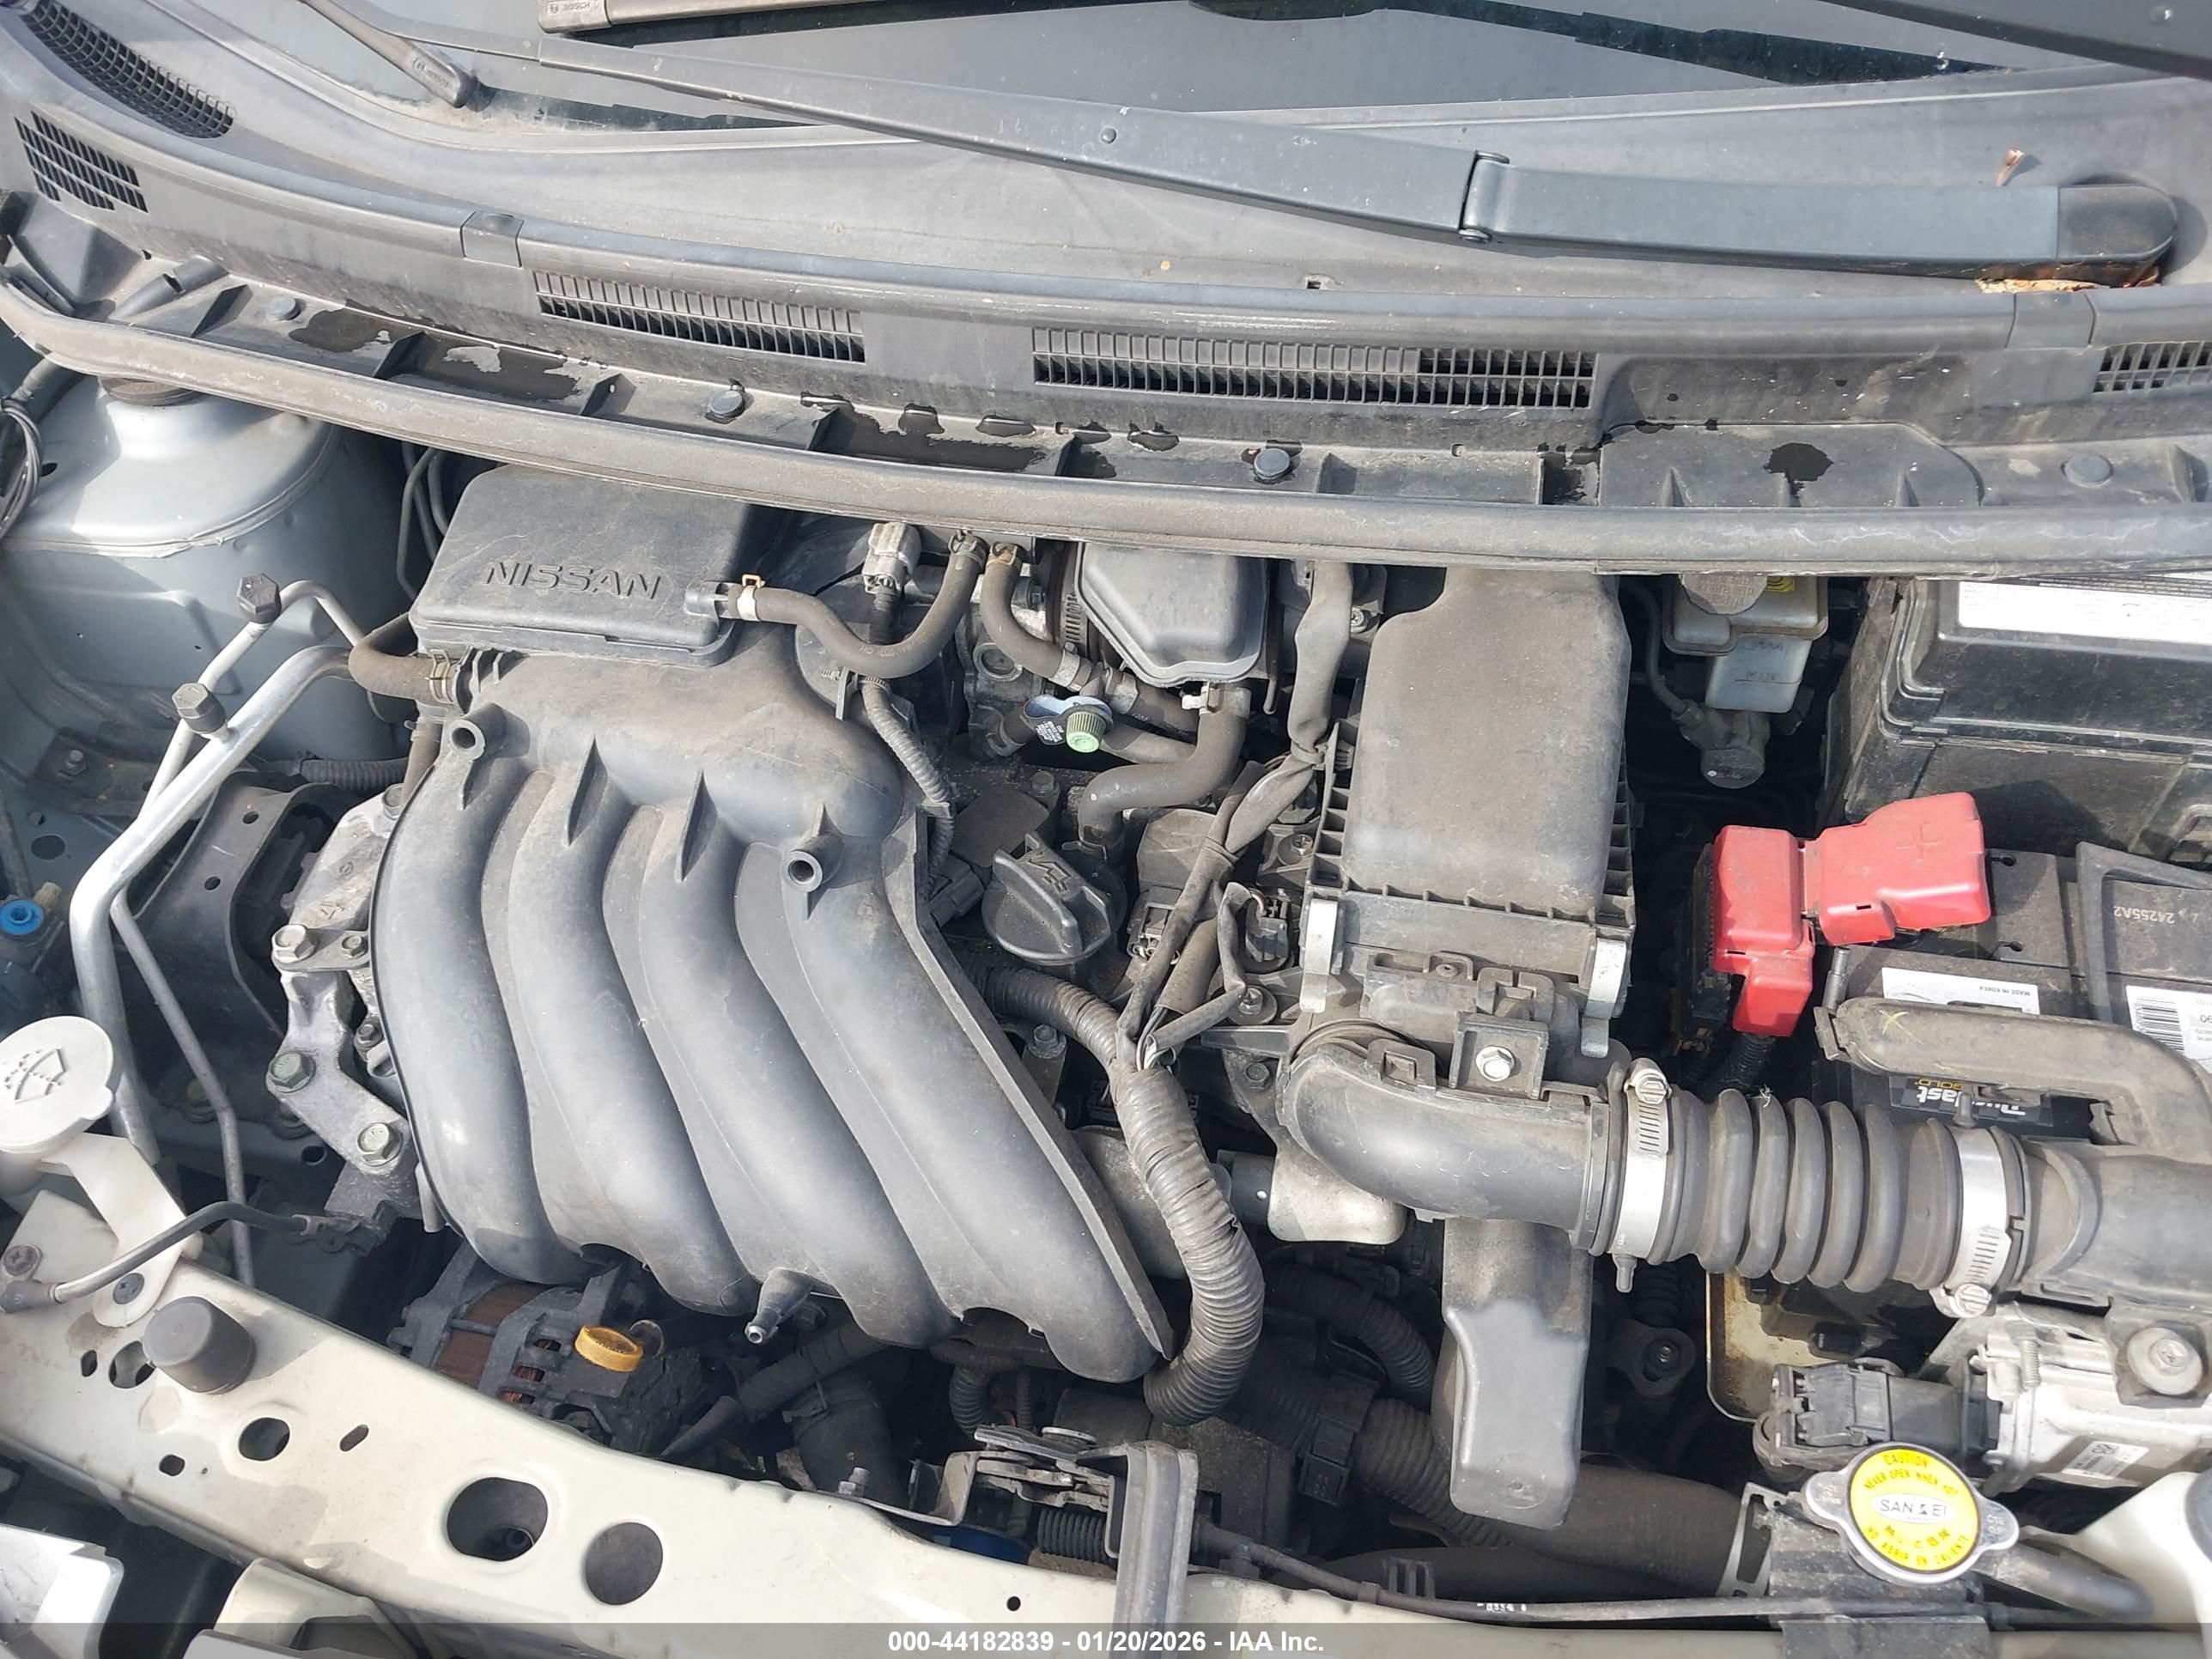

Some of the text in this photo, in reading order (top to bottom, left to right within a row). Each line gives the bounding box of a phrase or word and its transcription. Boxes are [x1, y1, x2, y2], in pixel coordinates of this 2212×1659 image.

[481, 562, 661, 599] NISSAN
[2113, 905, 2176, 925] 24255A2
[1883, 1451, 1929, 1468] CAUTION
[1863, 1472, 1887, 1490] NEVER
[1890, 1469, 1910, 1479] OPEN
[1916, 1472, 1938, 1485] WHEN
